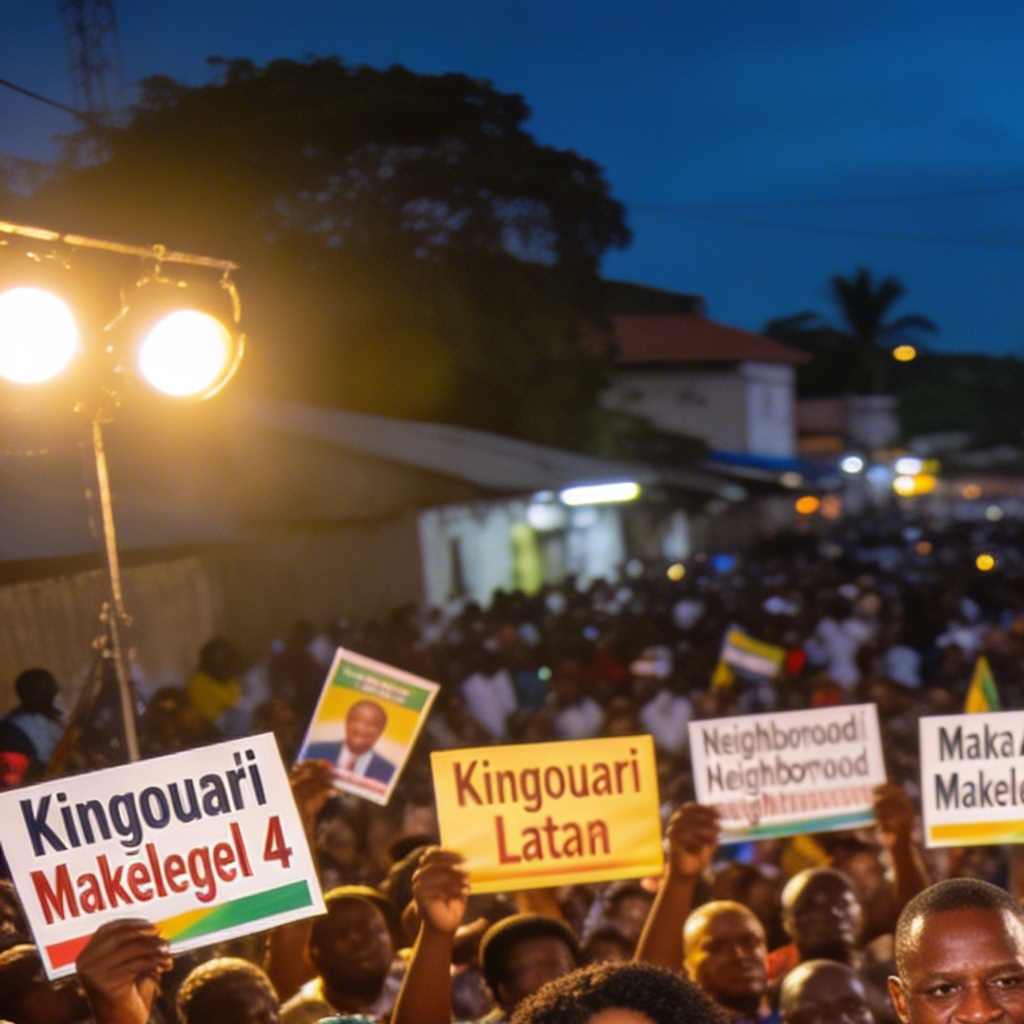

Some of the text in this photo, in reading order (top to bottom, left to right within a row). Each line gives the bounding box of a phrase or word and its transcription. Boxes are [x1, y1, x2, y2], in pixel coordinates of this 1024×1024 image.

[938, 724, 1015, 762] Maka
[453, 748, 641, 812] Kingouari
[495, 815, 610, 865] Latan
[30, 815, 293, 925] Makelegel 4
